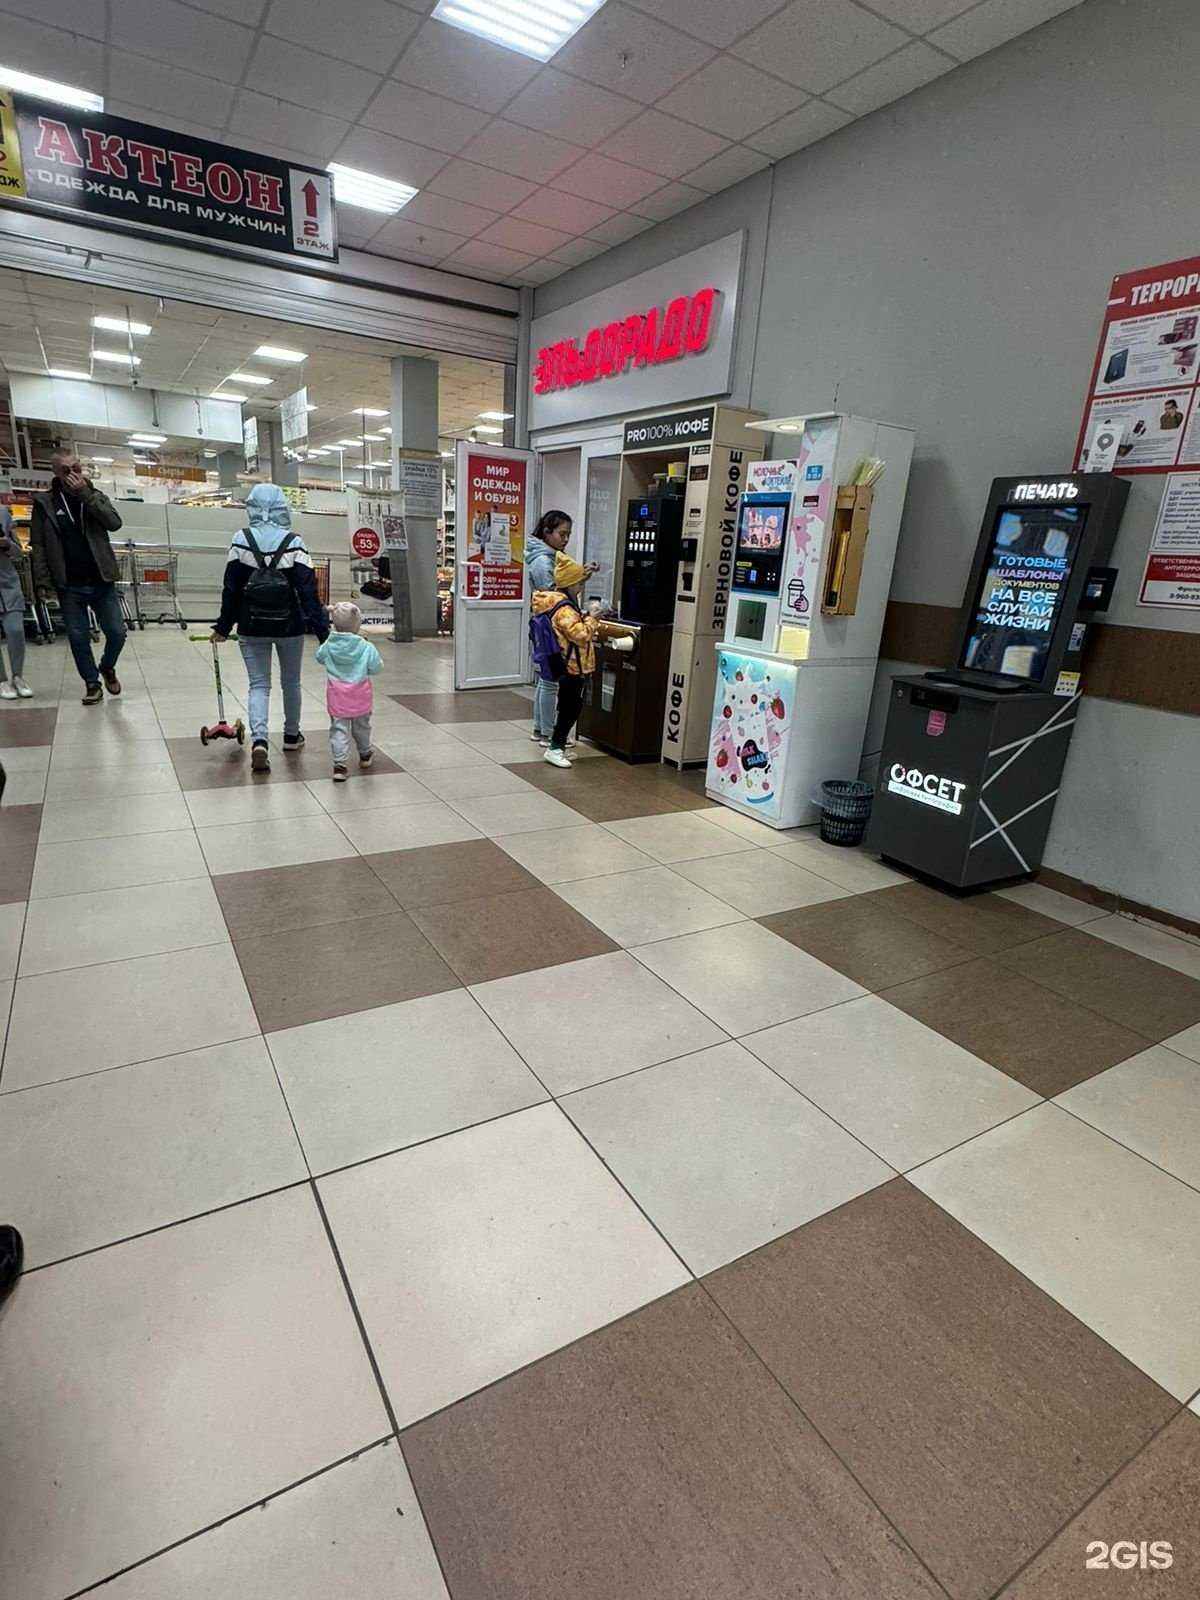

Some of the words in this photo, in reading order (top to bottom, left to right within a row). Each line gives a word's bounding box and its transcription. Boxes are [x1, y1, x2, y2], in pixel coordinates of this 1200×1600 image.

[35, 116, 285, 215] АКТЕОН
[37, 169, 140, 203] ОДЕЖДА
[147, 195, 190, 214] ДЛЯ
[196, 206, 287, 236] МУЖЧИН
[303, 220, 320, 238] 2
[296, 236, 330, 250] ЭТАЖ
[674, 417, 710, 435] КОФЕ
[486, 465, 510, 477] МИР
[473, 477, 521, 492] ОДЕЖДЫ
[1014, 482, 1079, 500] ПЕЧАТЬ
[474, 490, 483, 501] И
[484, 492, 520, 505] ОБУВИ
[711, 519, 737, 630] ЗЕРНОВОЙ
[724, 450, 743, 513] КОФЕ
[998, 556, 1068, 569] ГОТОВЫЕ
[996, 568, 1064, 581] ШАБЛОНЫ
[992, 578, 1060, 590] ДОКУМЕНТОВ
[991, 588, 1015, 601] НА
[1018, 589, 1058, 605] ВСЕ
[987, 601, 1054, 618] СЛУЧАИ
[984, 613, 1050, 631] ЖИЗНИ
[666, 672, 685, 744] КОФЕ
[890, 763, 966, 802] ОФСЕТ
